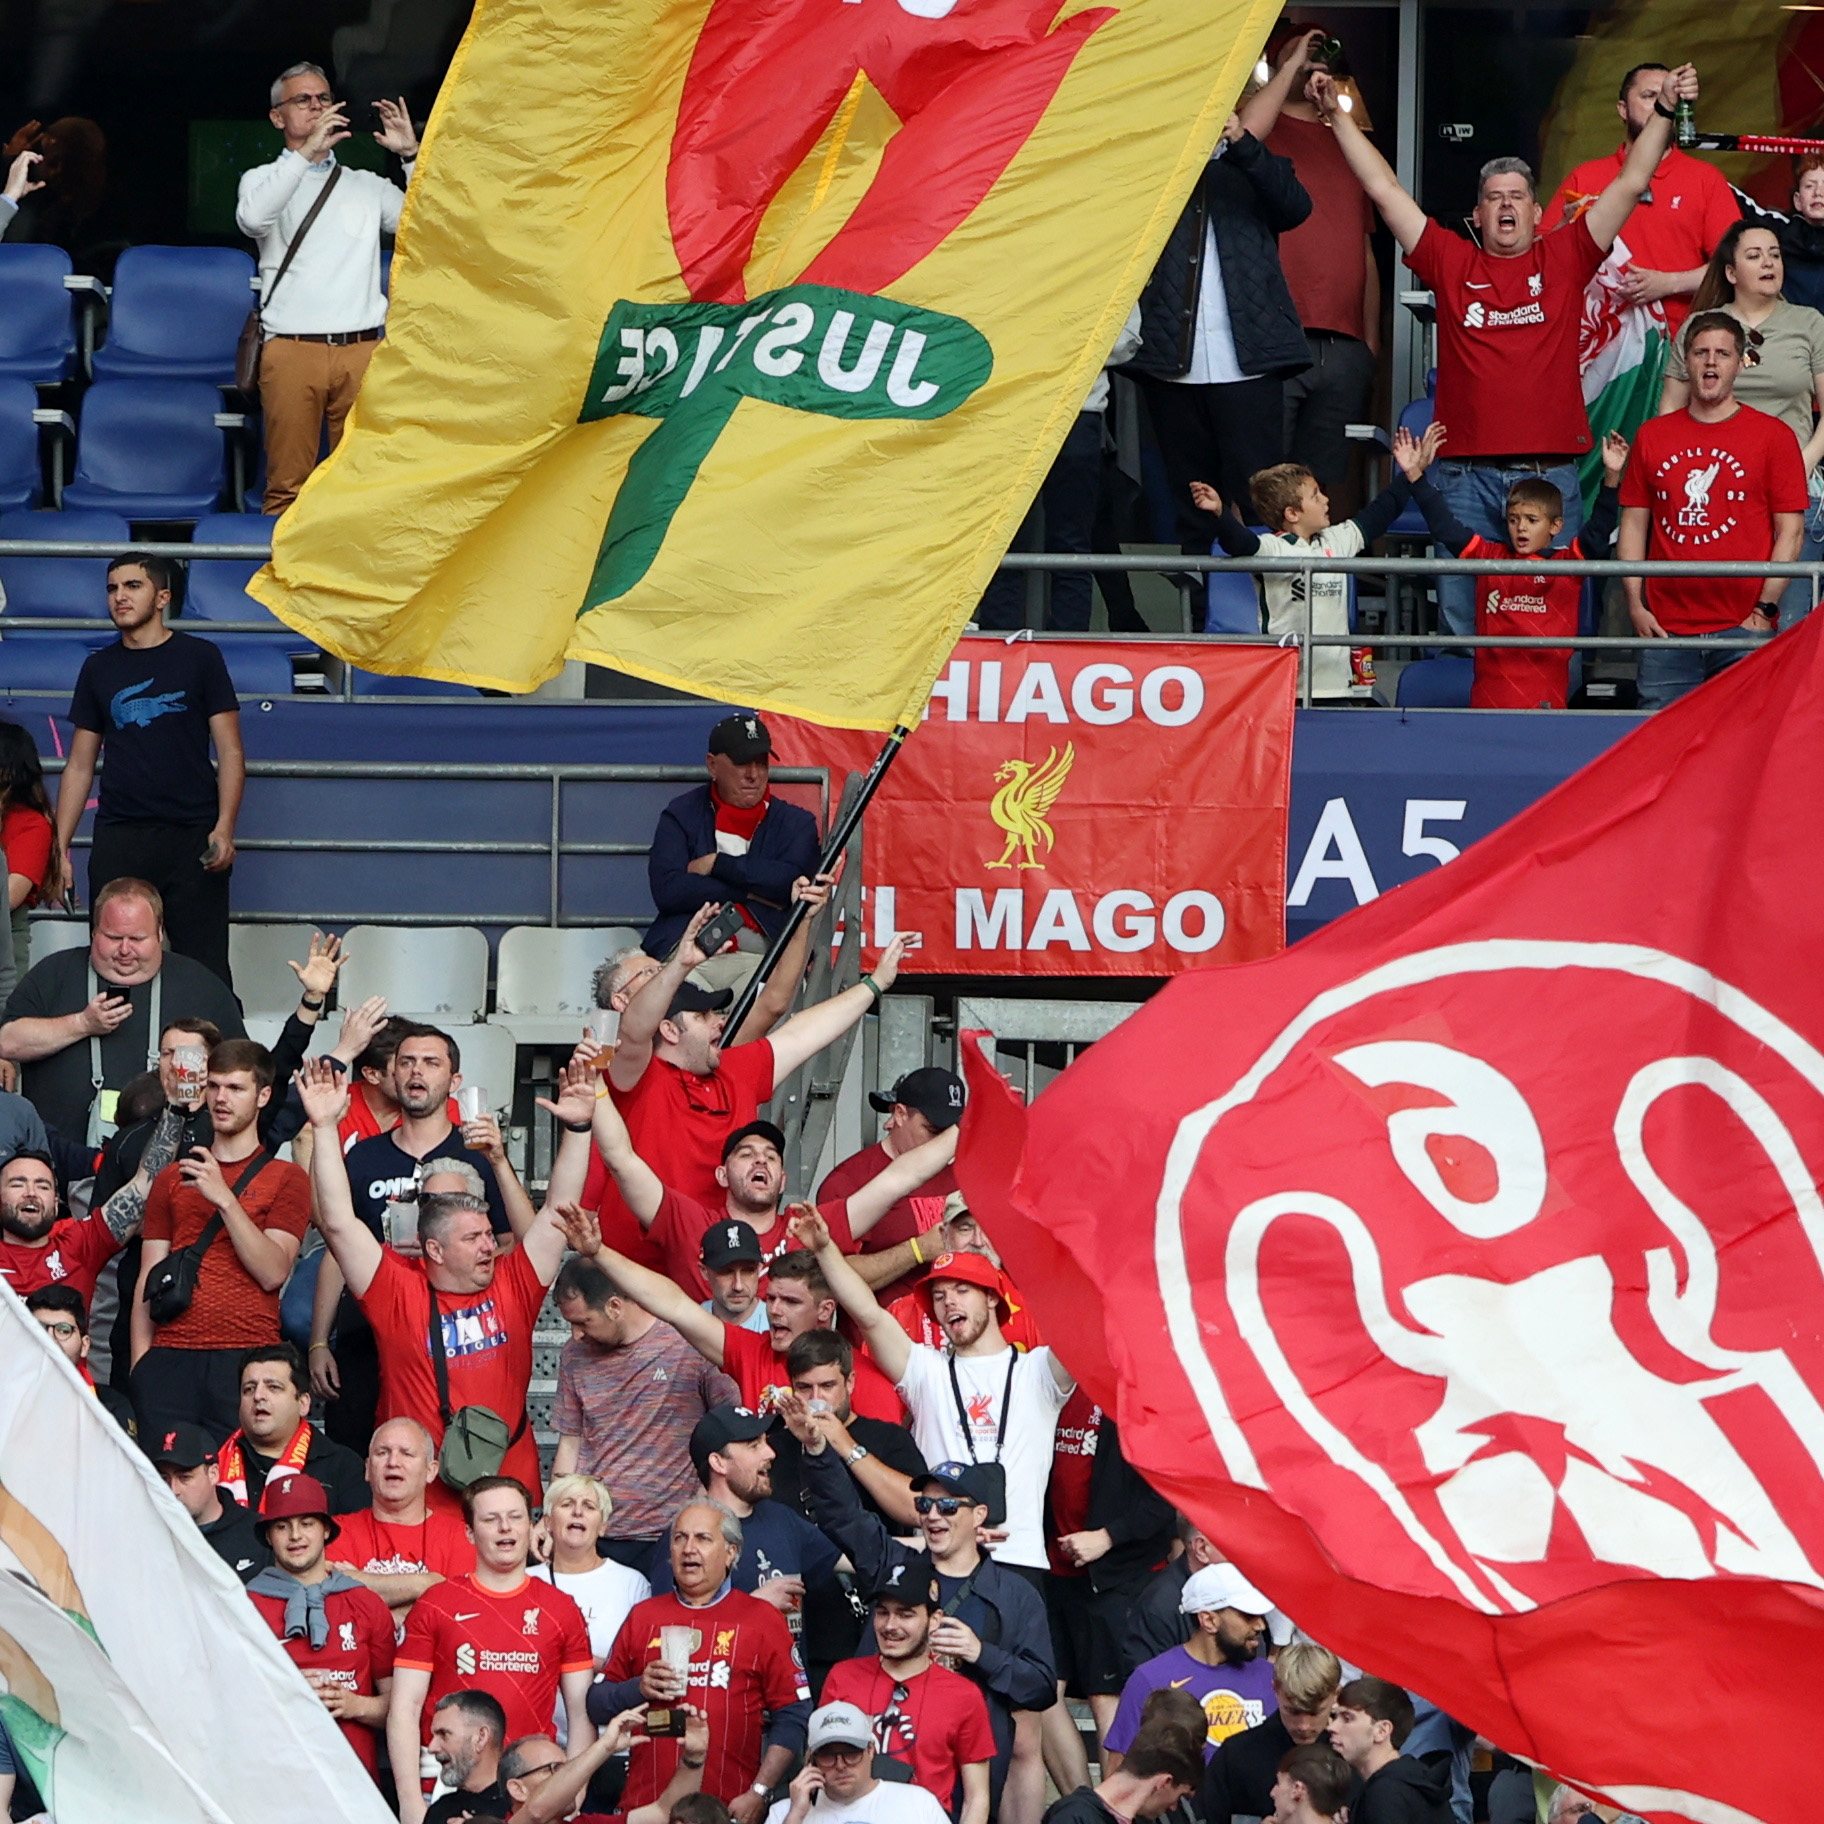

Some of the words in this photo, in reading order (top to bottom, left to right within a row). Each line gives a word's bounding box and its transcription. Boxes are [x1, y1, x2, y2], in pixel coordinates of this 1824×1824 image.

[1488, 302, 1539, 319] standard
[956, 888, 1224, 952] MAGO
[480, 1650, 539, 1663] standard
[479, 1661, 540, 1674] chartered
